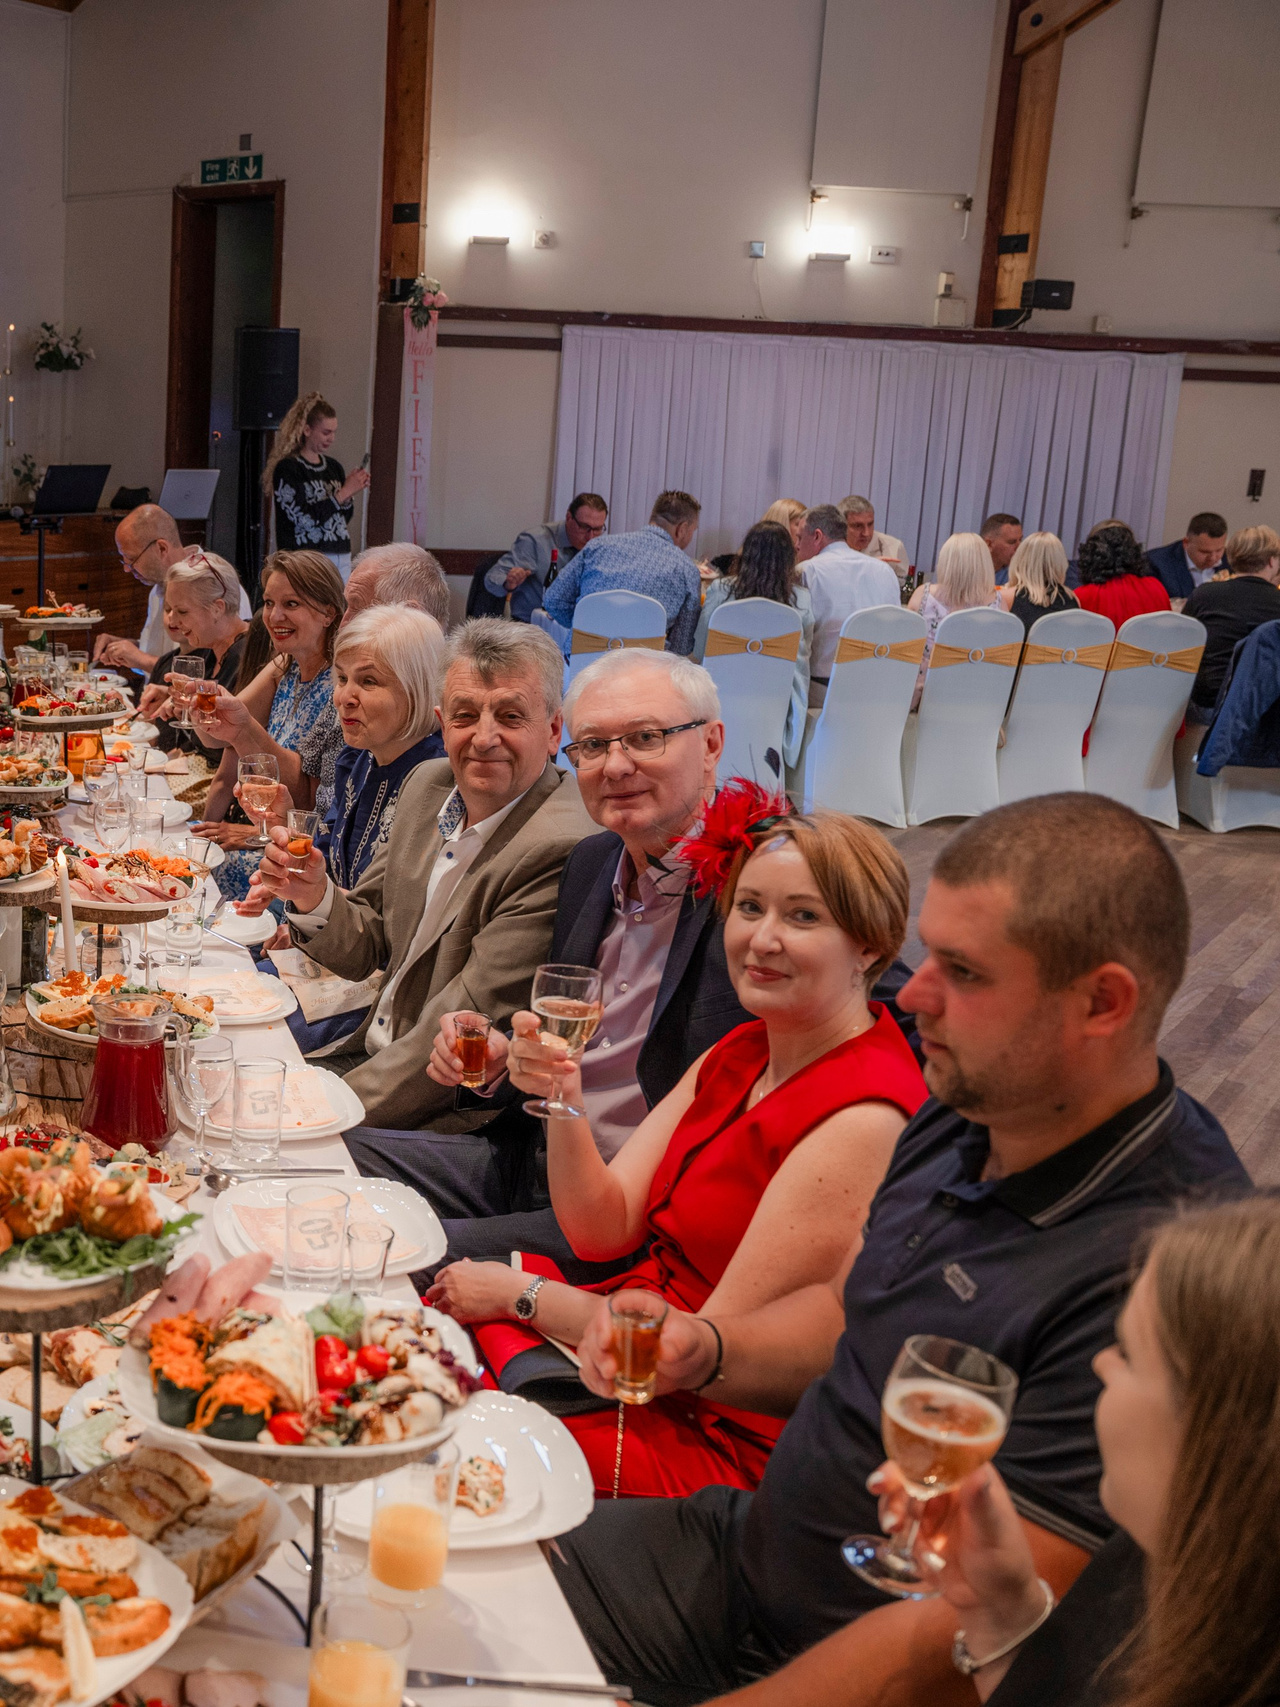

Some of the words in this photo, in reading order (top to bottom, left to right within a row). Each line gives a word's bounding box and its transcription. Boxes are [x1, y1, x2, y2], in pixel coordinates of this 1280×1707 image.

[206, 163, 220, 172] Fire
[206, 172, 219, 181] exit
[410, 360, 425, 545] FIFTY
